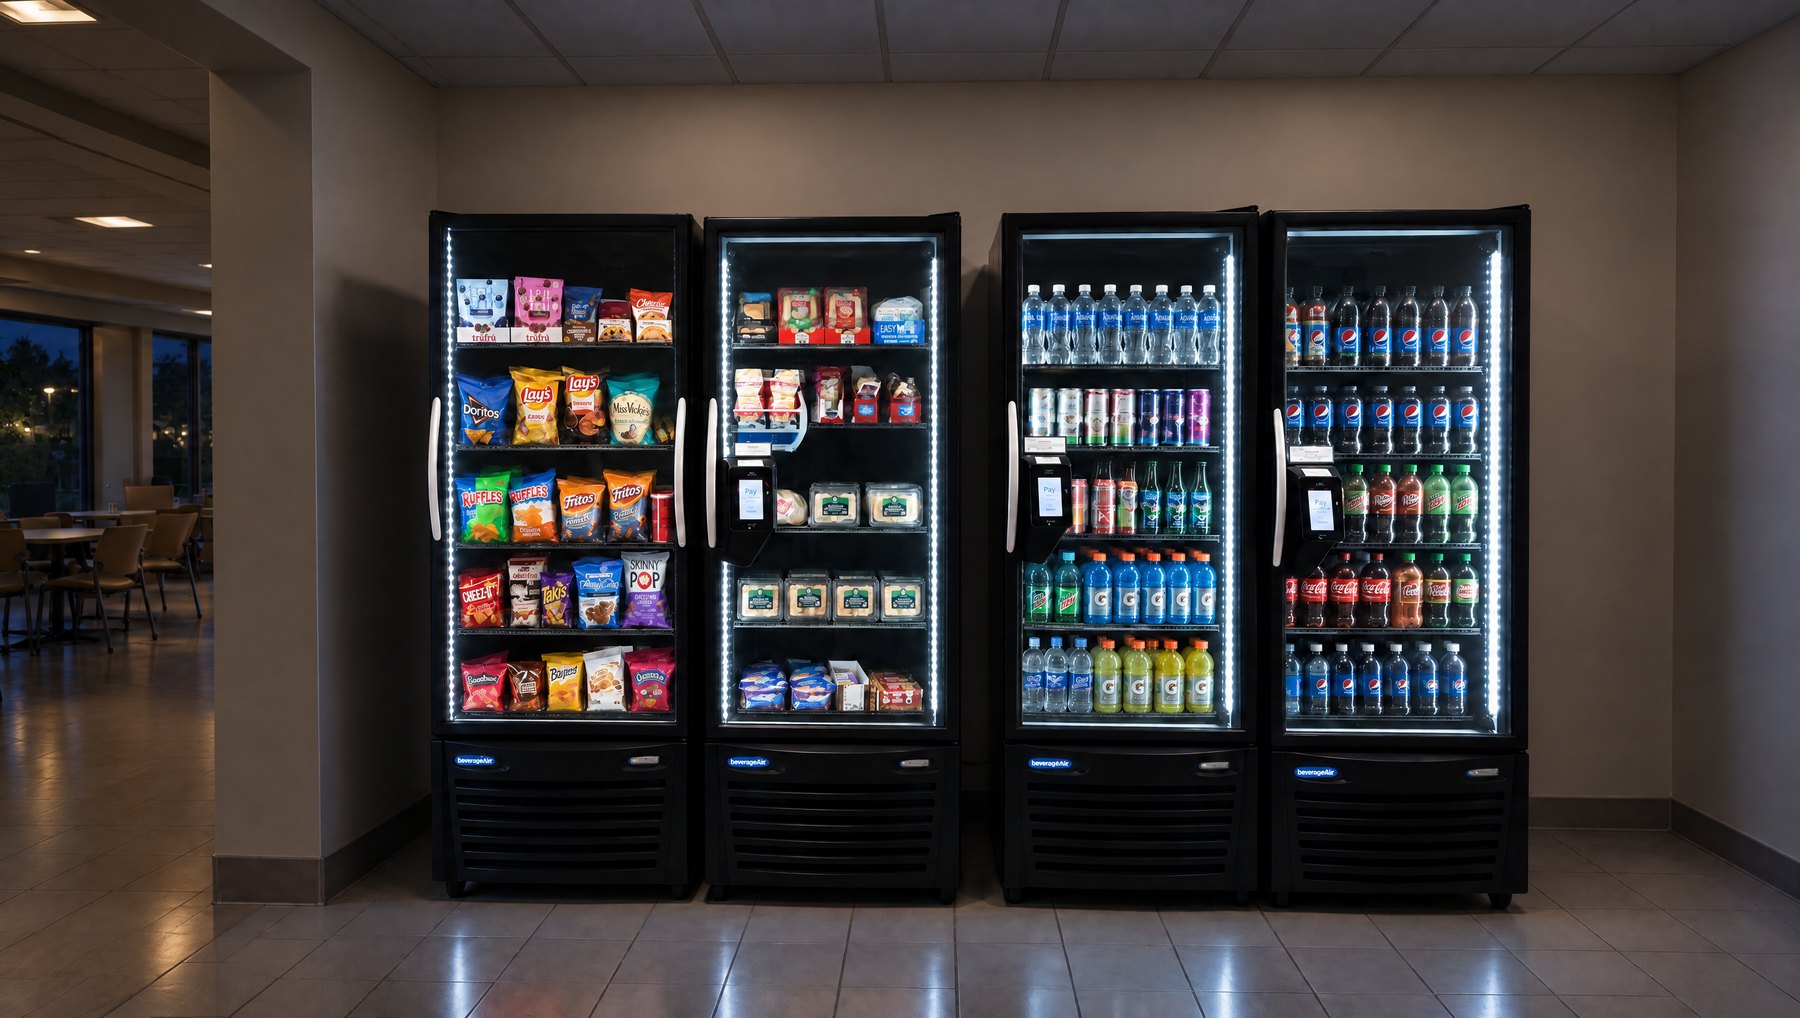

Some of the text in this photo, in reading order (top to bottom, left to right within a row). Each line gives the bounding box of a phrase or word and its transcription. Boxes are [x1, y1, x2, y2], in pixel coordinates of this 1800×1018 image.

[880, 325, 896, 333] EASY
[472, 333, 496, 342] trúfrú
[526, 333, 550, 342] trúfrú
[568, 375, 597, 391] Lay's
[522, 386, 553, 403] Lay's
[463, 403, 500, 419] Doritos
[613, 402, 651, 417] Miss Vickie's
[462, 490, 503, 506] RUFFLES
[510, 485, 548, 502] RUFFLES
[612, 485, 642, 503] Fritos
[564, 493, 594, 510] Fritos
[630, 559, 661, 571] SKINNY
[541, 585, 567, 604] Takis
[457, 756, 493, 765] beverageAir
[730, 758, 767, 767] beverageAir
[1031, 759, 1069, 768] beverageAir
[1297, 768, 1335, 777] beverageAir
